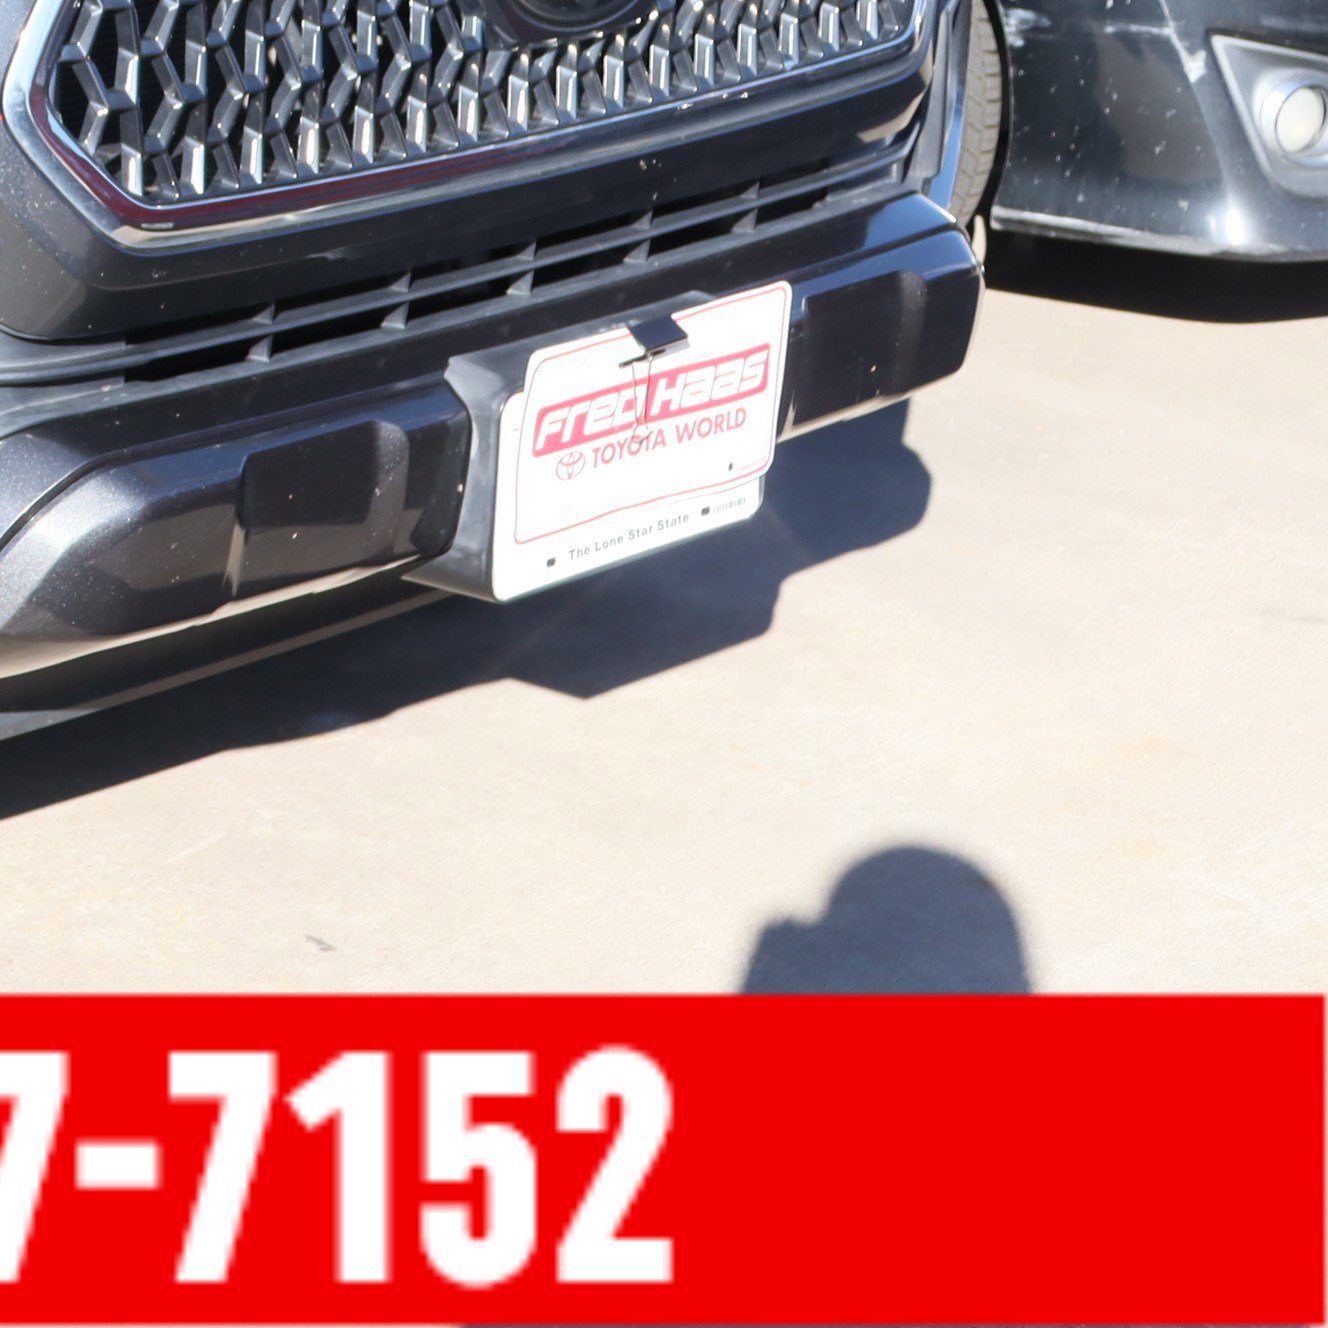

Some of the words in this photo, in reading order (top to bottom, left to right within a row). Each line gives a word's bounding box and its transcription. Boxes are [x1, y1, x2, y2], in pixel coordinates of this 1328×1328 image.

[591, 427, 667, 468] TOYOTA
[674, 407, 747, 448] WORLD
[568, 546, 591, 561] The
[594, 535, 624, 554] Lone
[627, 523, 653, 541] Star
[656, 512, 690, 532] State
